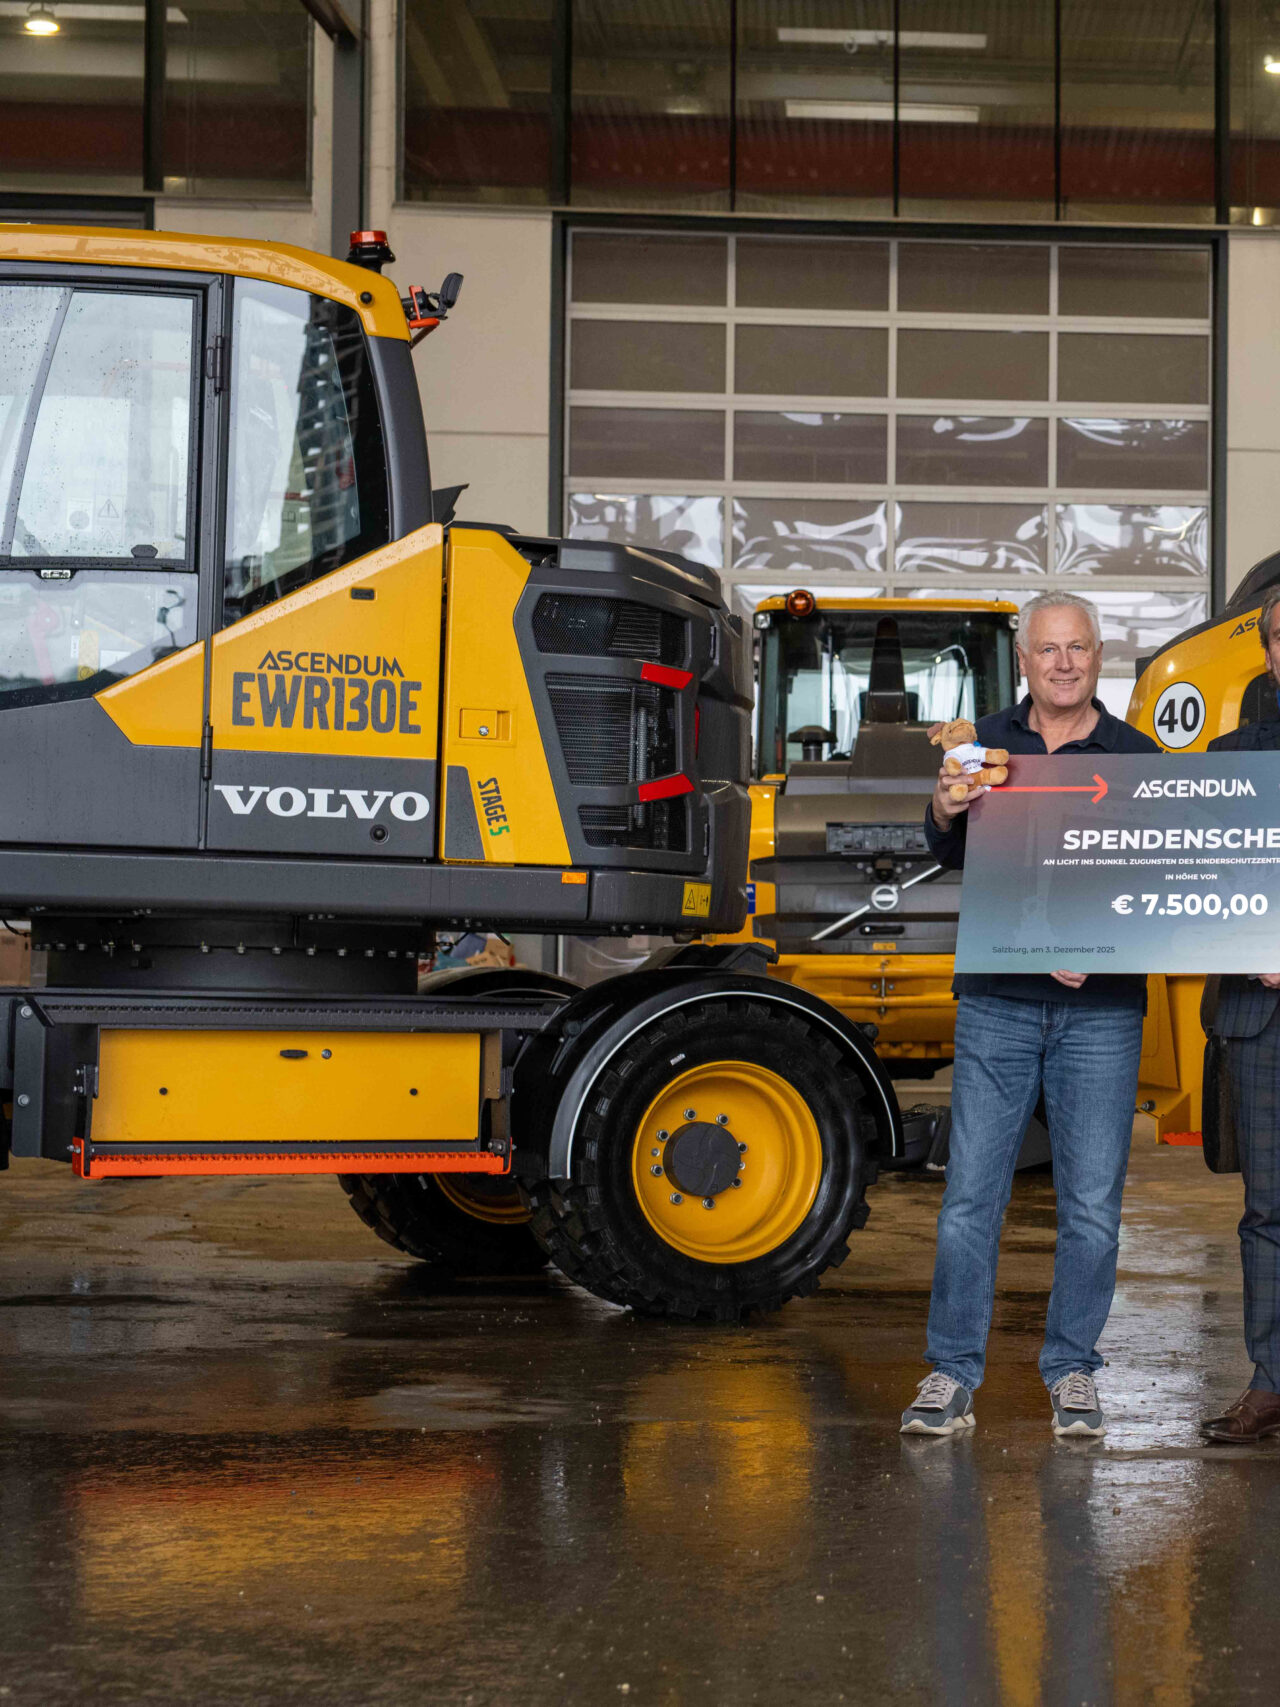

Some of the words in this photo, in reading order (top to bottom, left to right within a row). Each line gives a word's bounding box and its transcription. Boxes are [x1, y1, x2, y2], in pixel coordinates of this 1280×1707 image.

[257, 650, 405, 678] ASCENDUM
[232, 671, 422, 734] EWR130E
[1158, 696, 1200, 733] 40
[477, 777, 507, 826] STAGE
[1132, 778, 1257, 799] ASCENDUM
[214, 785, 430, 822] VOLVO
[489, 825, 511, 837] 5
[1081, 858, 1094, 866] INS
[1096, 858, 1128, 866] DUNKEL
[1175, 872, 1198, 880] HÖHE
[1111, 894, 1134, 915] €
[1141, 893, 1269, 920] 7.500,00
[992, 946, 1029, 955] Salzburg,
